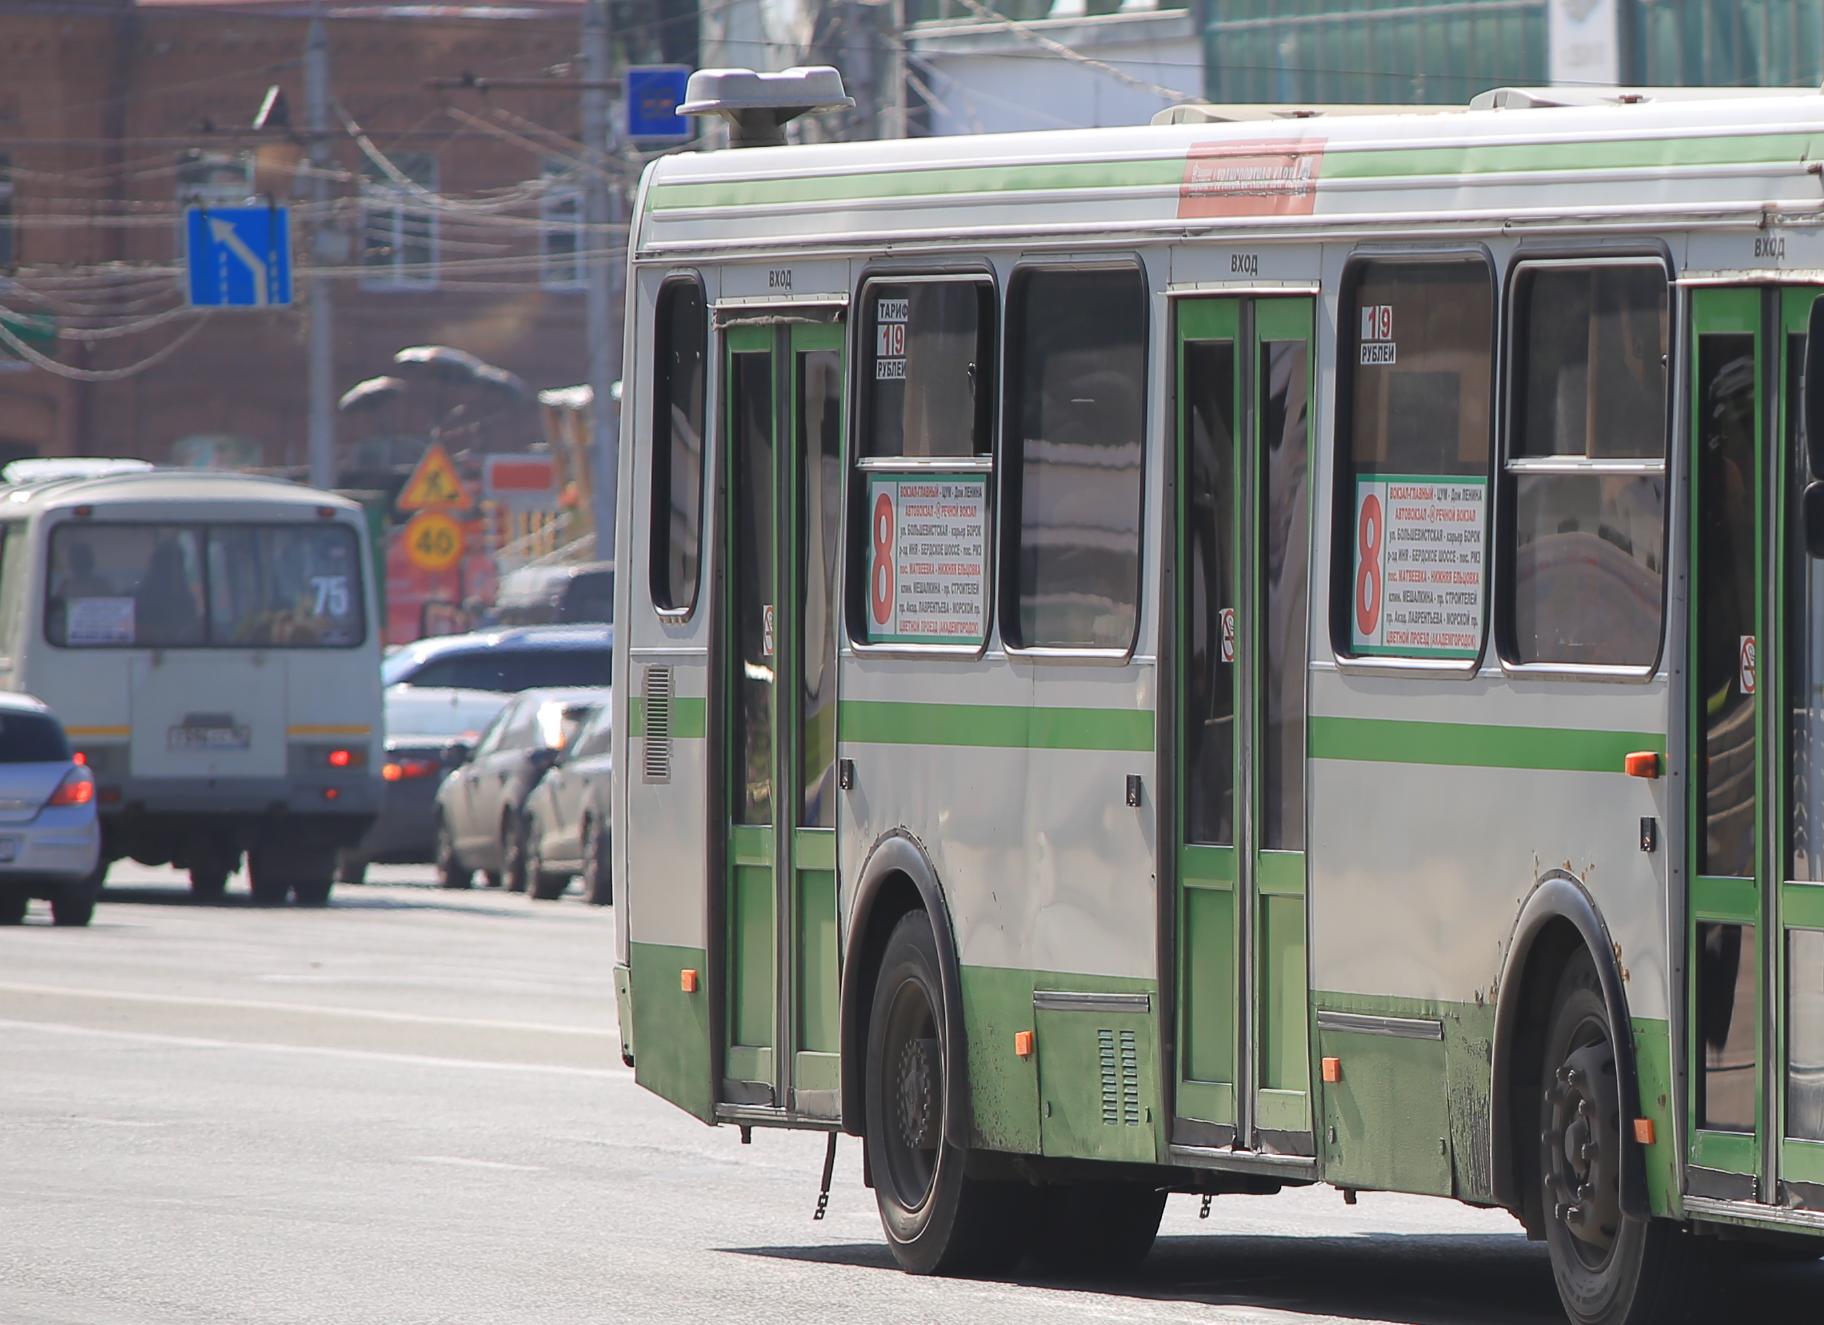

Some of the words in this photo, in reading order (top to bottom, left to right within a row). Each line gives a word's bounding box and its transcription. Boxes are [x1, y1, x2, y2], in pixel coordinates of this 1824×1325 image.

[1754, 237, 1785, 260] ВХОД
[1231, 254, 1258, 276] ВХОД
[769, 269, 792, 290] ВХОД
[880, 303, 908, 319] ТАРИФ
[1368, 307, 1391, 339] 19
[883, 325, 903, 356] 19
[1462, 489, 1482, 501] ЛЕНИНА
[1395, 507, 1426, 520] АВТОВОКЗАЛ
[1457, 509, 1476, 522] ВОКЗАЛ
[416, 528, 453, 554] 40
[1397, 528, 1443, 540] БОЛЬШЕВИСТСКАЯ
[1464, 530, 1480, 542] БОРОК
[872, 493, 893, 624] 8
[1356, 494, 1382, 635] 8
[1412, 549, 1437, 564] БЕРДСКОЕ
[1438, 550, 1456, 562] ШОССЕ
[1399, 570, 1426, 582] МАТВЕЕВКА
[1431, 570, 1452, 583] НИЖНЯЯ
[312, 576, 348, 616] 75
[1403, 591, 1433, 603] МЕШАЛКИНА
[1408, 611, 1442, 624] ЛАВРЕНТЬЕВА
[1446, 610, 1470, 626] МОРСКОЙ
[1386, 629, 1409, 644] ЦВЕТНОЙ
[1410, 631, 1429, 646] ПРОЕЗД
